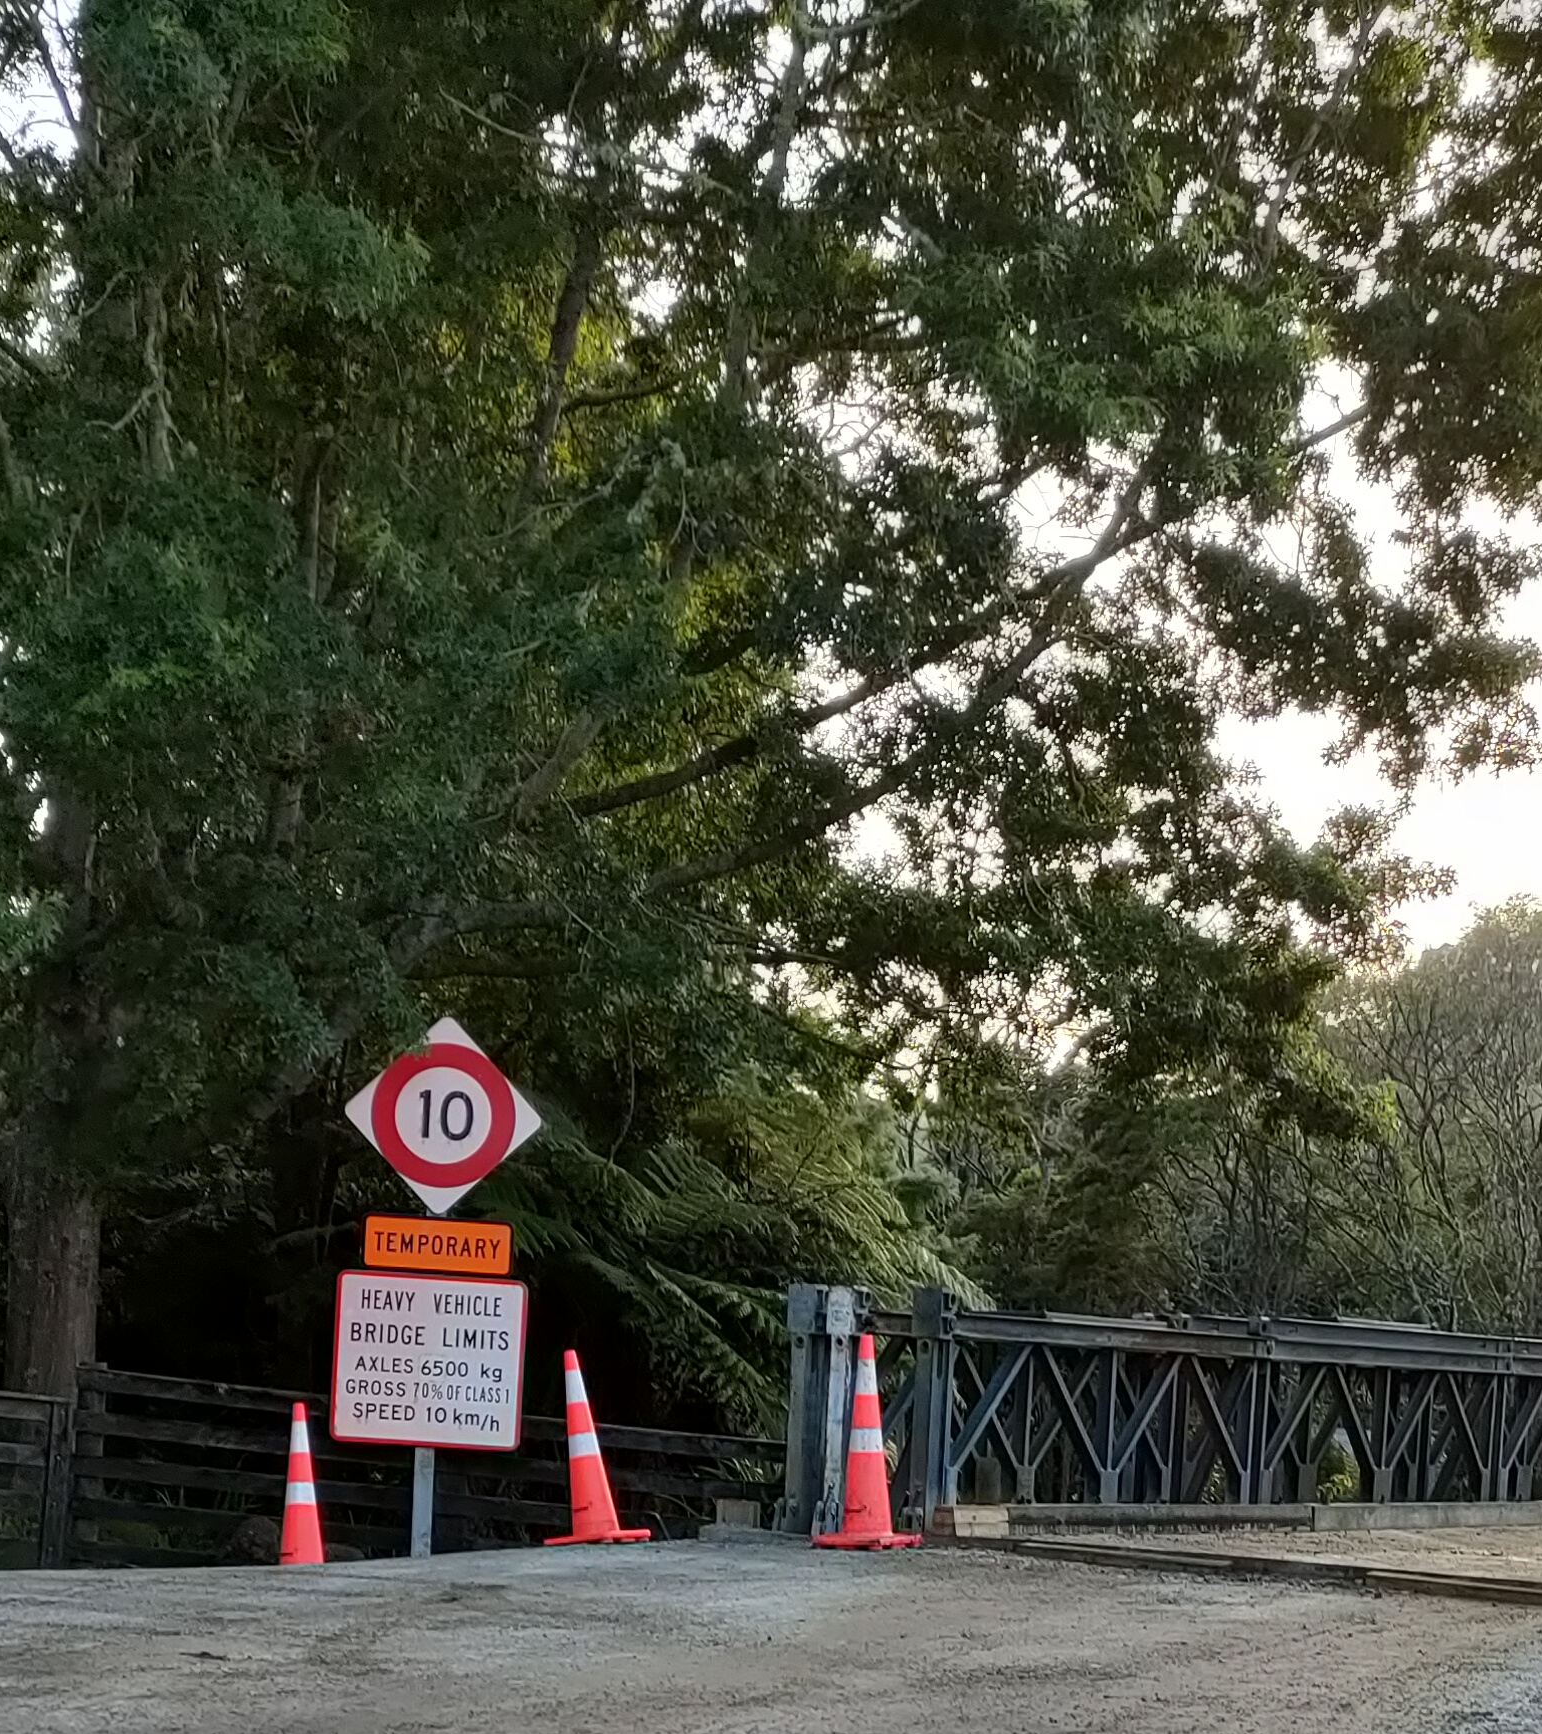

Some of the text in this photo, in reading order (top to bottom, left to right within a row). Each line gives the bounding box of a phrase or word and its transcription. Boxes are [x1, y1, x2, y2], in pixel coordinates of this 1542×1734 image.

[419, 1089, 474, 1142] 10
[374, 1231, 501, 1260] TEMPORARY
[361, 1288, 503, 1317] HEAVY VEHICLE
[350, 1322, 510, 1351] BRIDGE LIMITS
[354, 1355, 503, 1383] AXLES 6500 kg
[345, 1378, 407, 1397] GROSS
[413, 1382, 443, 1400] 70%
[446, 1384, 462, 1401] OF
[465, 1385, 501, 1404] CLASS
[352, 1402, 500, 1432] SPEED 10 km/h
